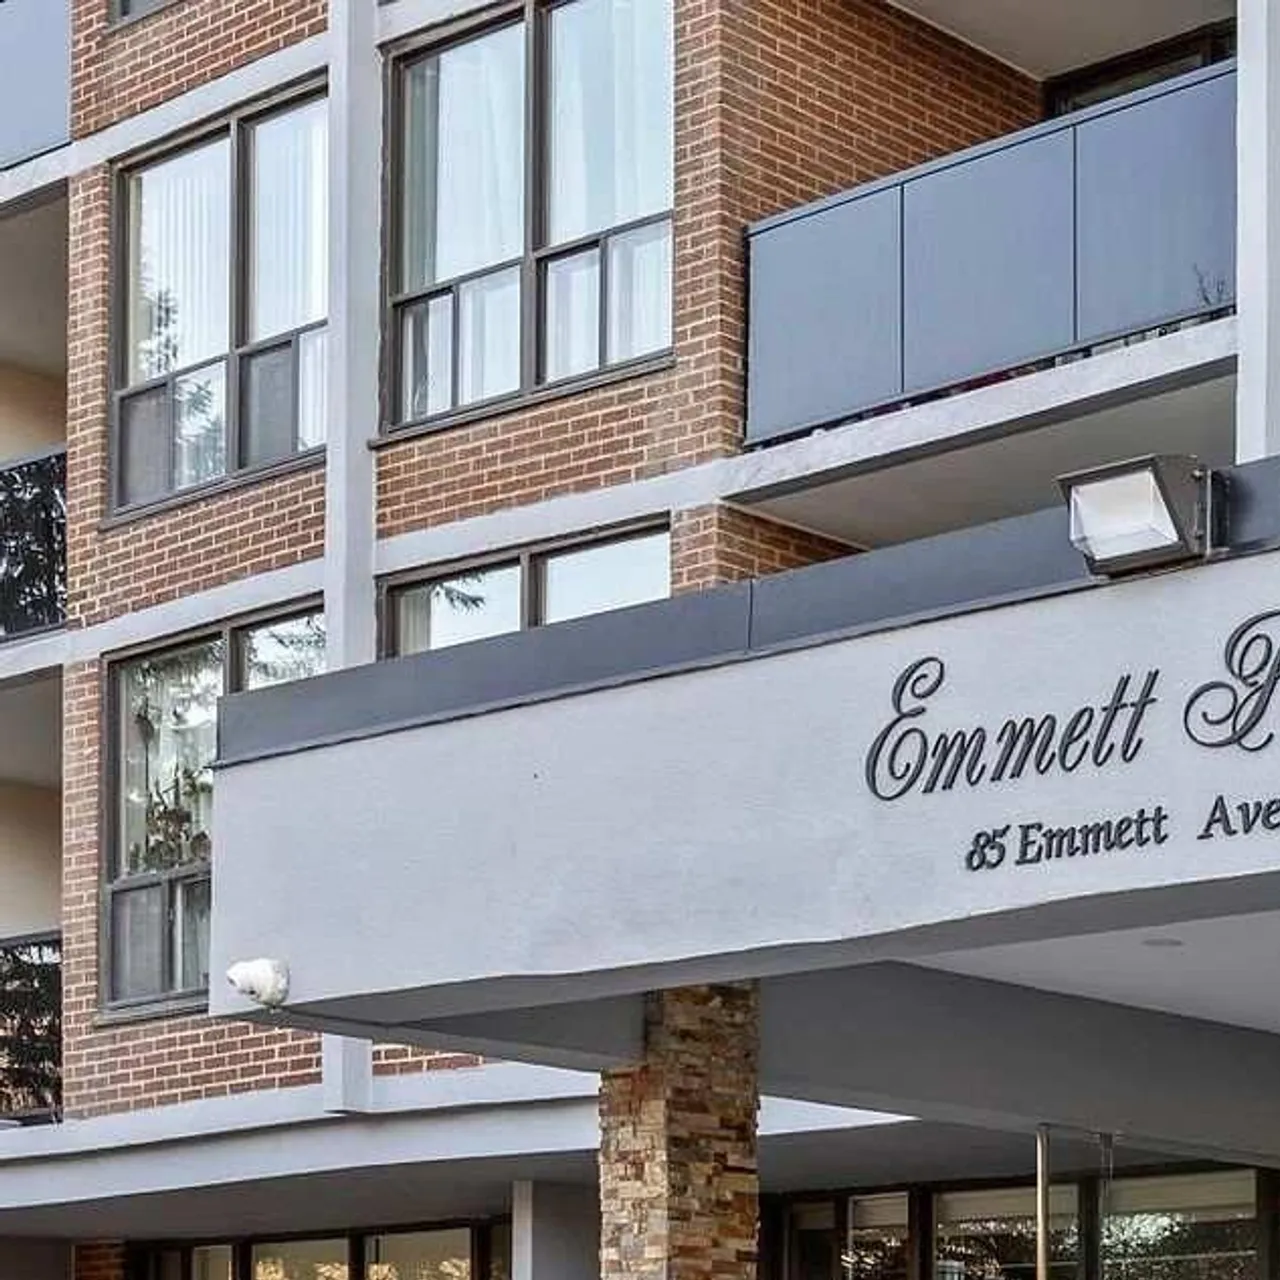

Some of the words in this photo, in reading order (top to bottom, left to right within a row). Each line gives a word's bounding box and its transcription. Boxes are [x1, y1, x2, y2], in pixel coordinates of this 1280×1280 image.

[865, 656, 1160, 802] Emmett
[965, 826, 1009, 872] 85
[1013, 805, 1169, 868] Emmett
